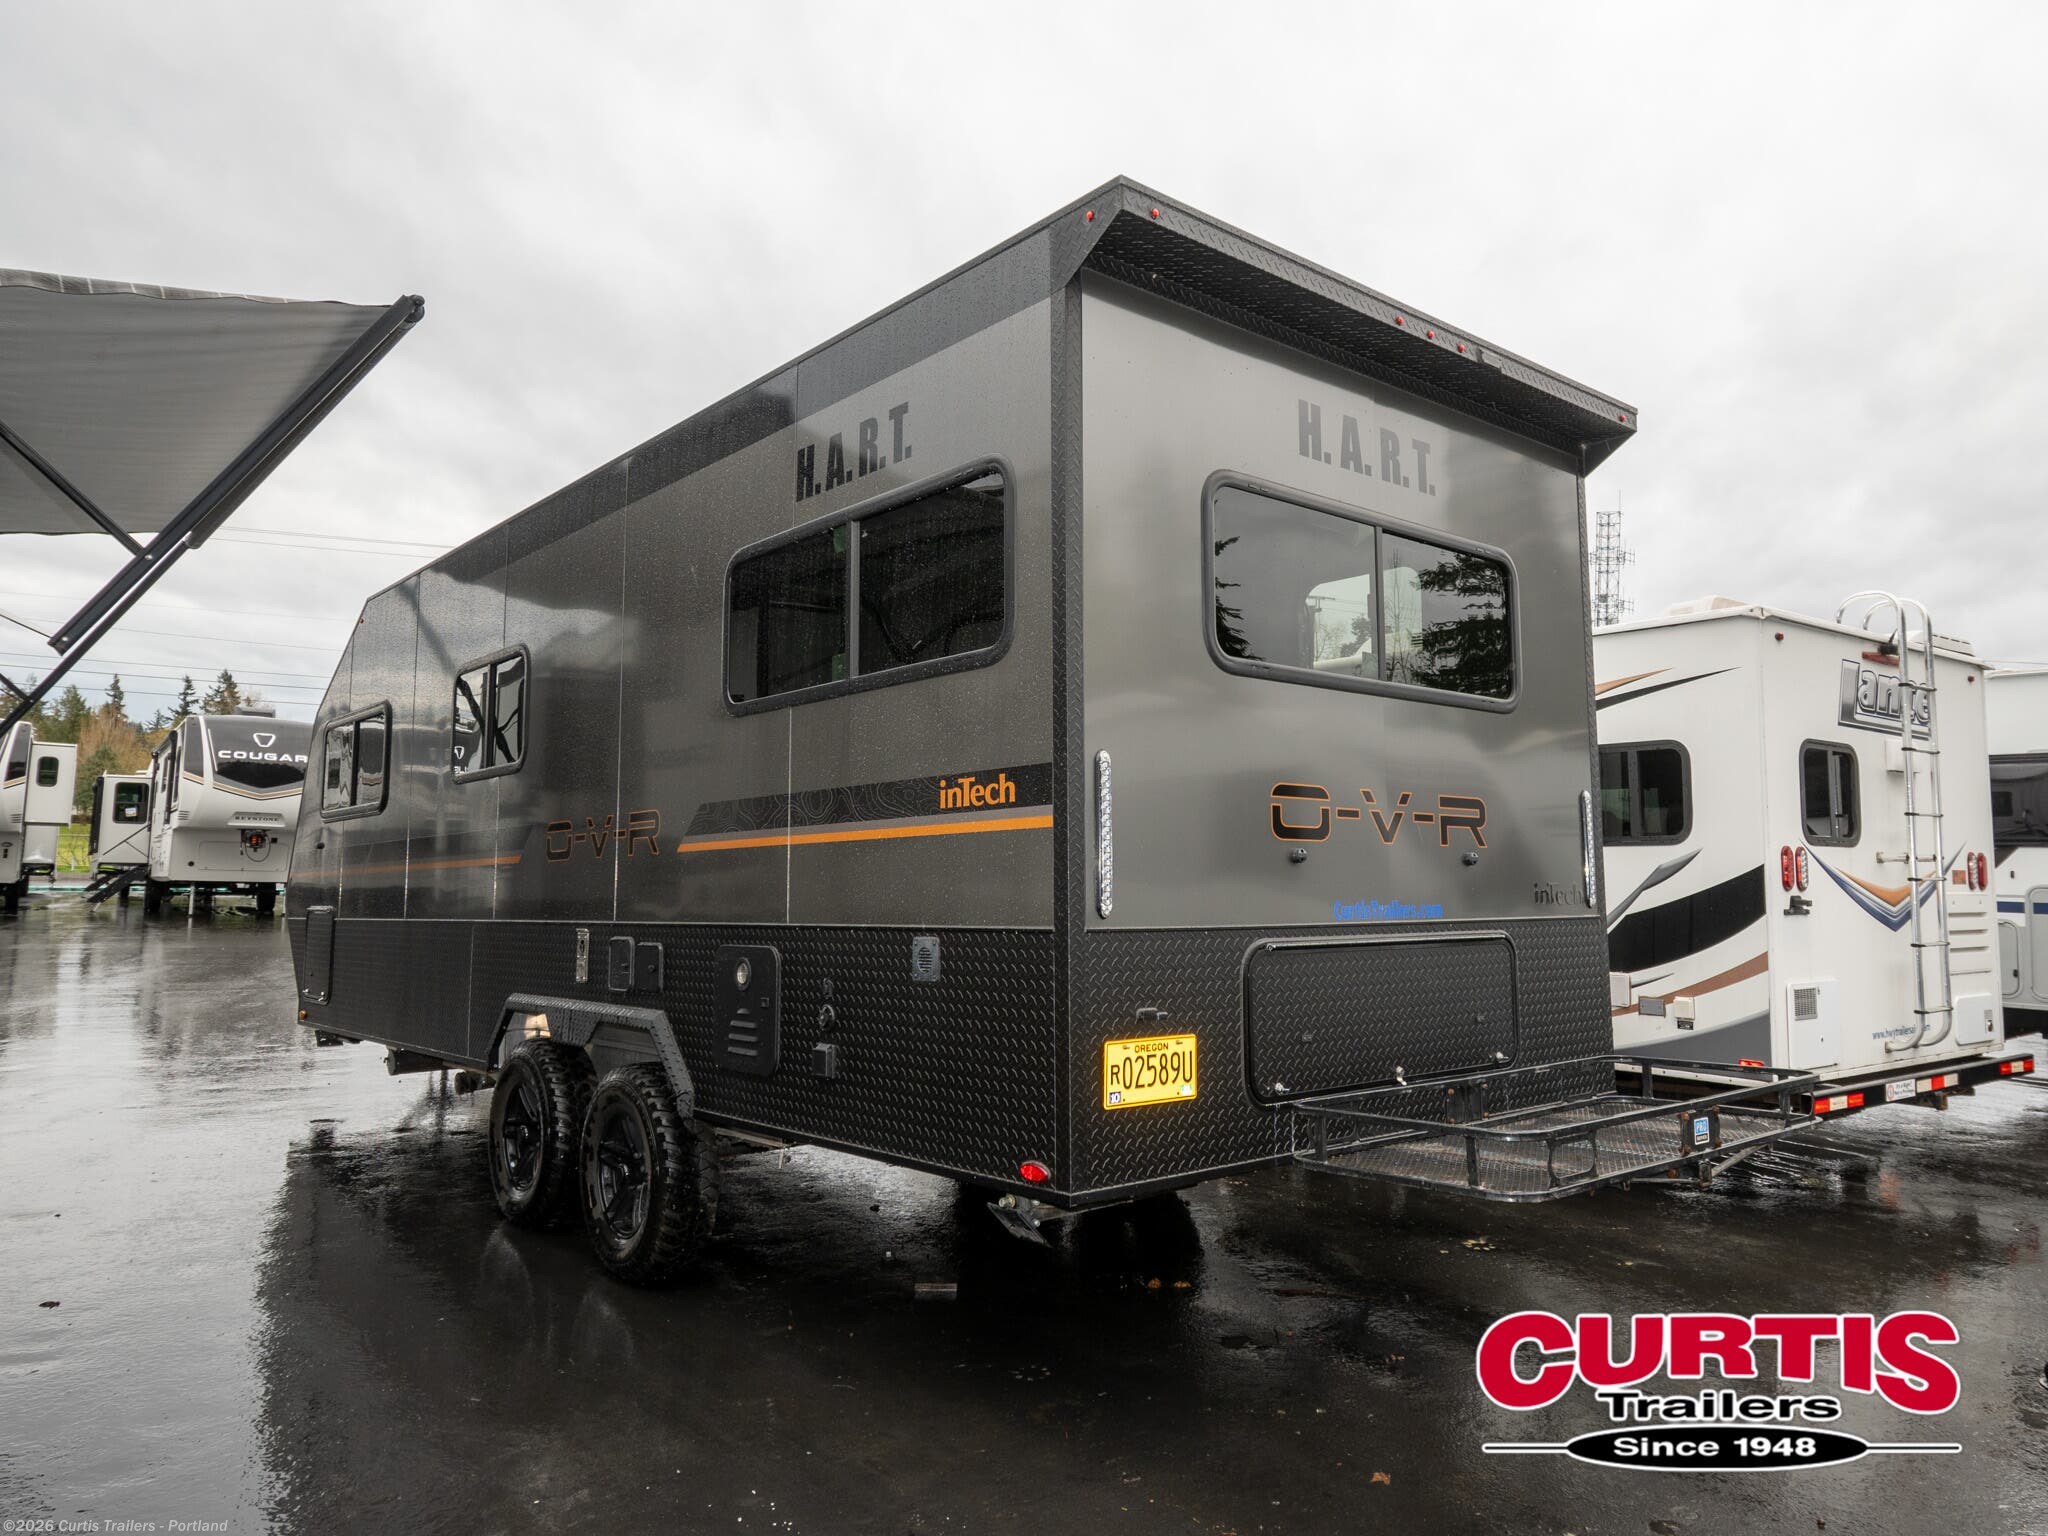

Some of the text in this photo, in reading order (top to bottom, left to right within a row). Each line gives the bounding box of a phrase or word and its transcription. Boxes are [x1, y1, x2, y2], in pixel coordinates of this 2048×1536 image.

[796, 401, 912, 503] H.A.R.T.
[1298, 398, 1436, 497] H.A.R.T.
[218, 750, 308, 763] COUGAR
[940, 773, 1016, 809] inTech
[234, 815, 281, 823] KEYSTONE
[1270, 782, 1488, 848] O-V-R
[546, 809, 660, 862] O-V-R
[1333, 900, 1443, 920] CurtisTrailers.com
[1533, 882, 1584, 905] inTech
[1134, 1043, 1169, 1053] OREGON
[1110, 1051, 1192, 1090] R02589U
